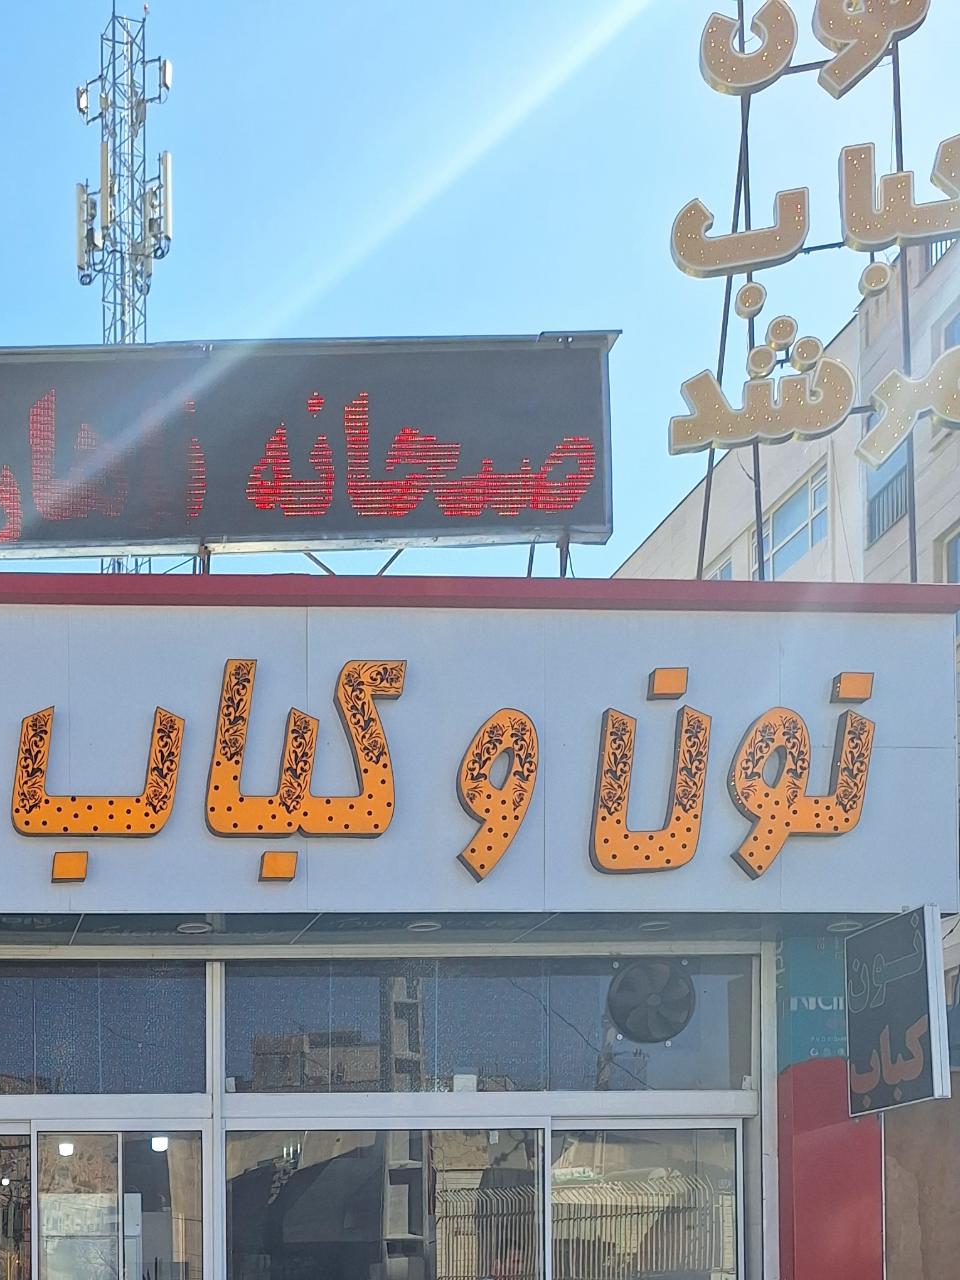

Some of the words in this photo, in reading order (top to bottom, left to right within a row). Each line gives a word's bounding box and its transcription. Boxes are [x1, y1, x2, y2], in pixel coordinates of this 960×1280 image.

[10, 658, 408, 885] کباب
[457, 707, 540, 883] و
[590, 666, 875, 880] نون
[847, 912, 926, 1015] نون
[849, 1013, 929, 1108] کباب
